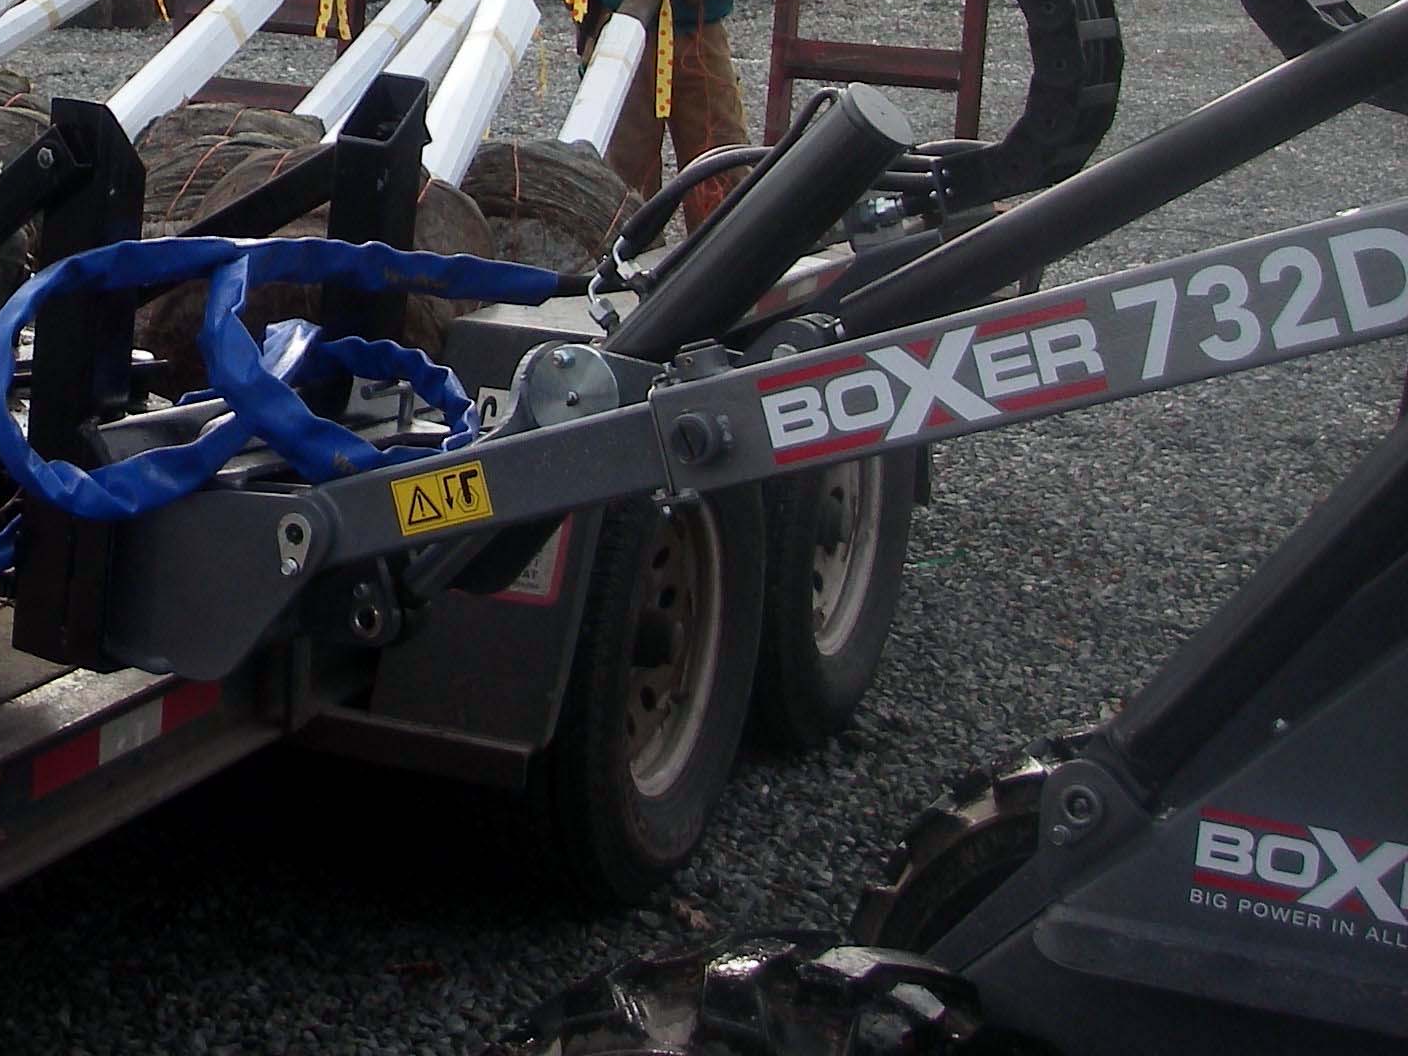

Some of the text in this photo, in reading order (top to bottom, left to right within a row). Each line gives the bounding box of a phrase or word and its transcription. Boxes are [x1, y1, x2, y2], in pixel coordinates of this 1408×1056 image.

[760, 227, 1408, 449] BOXER 732D
[1189, 888, 1408, 948] BIG POWER IN ALL
[1195, 820, 1408, 926] BOX
